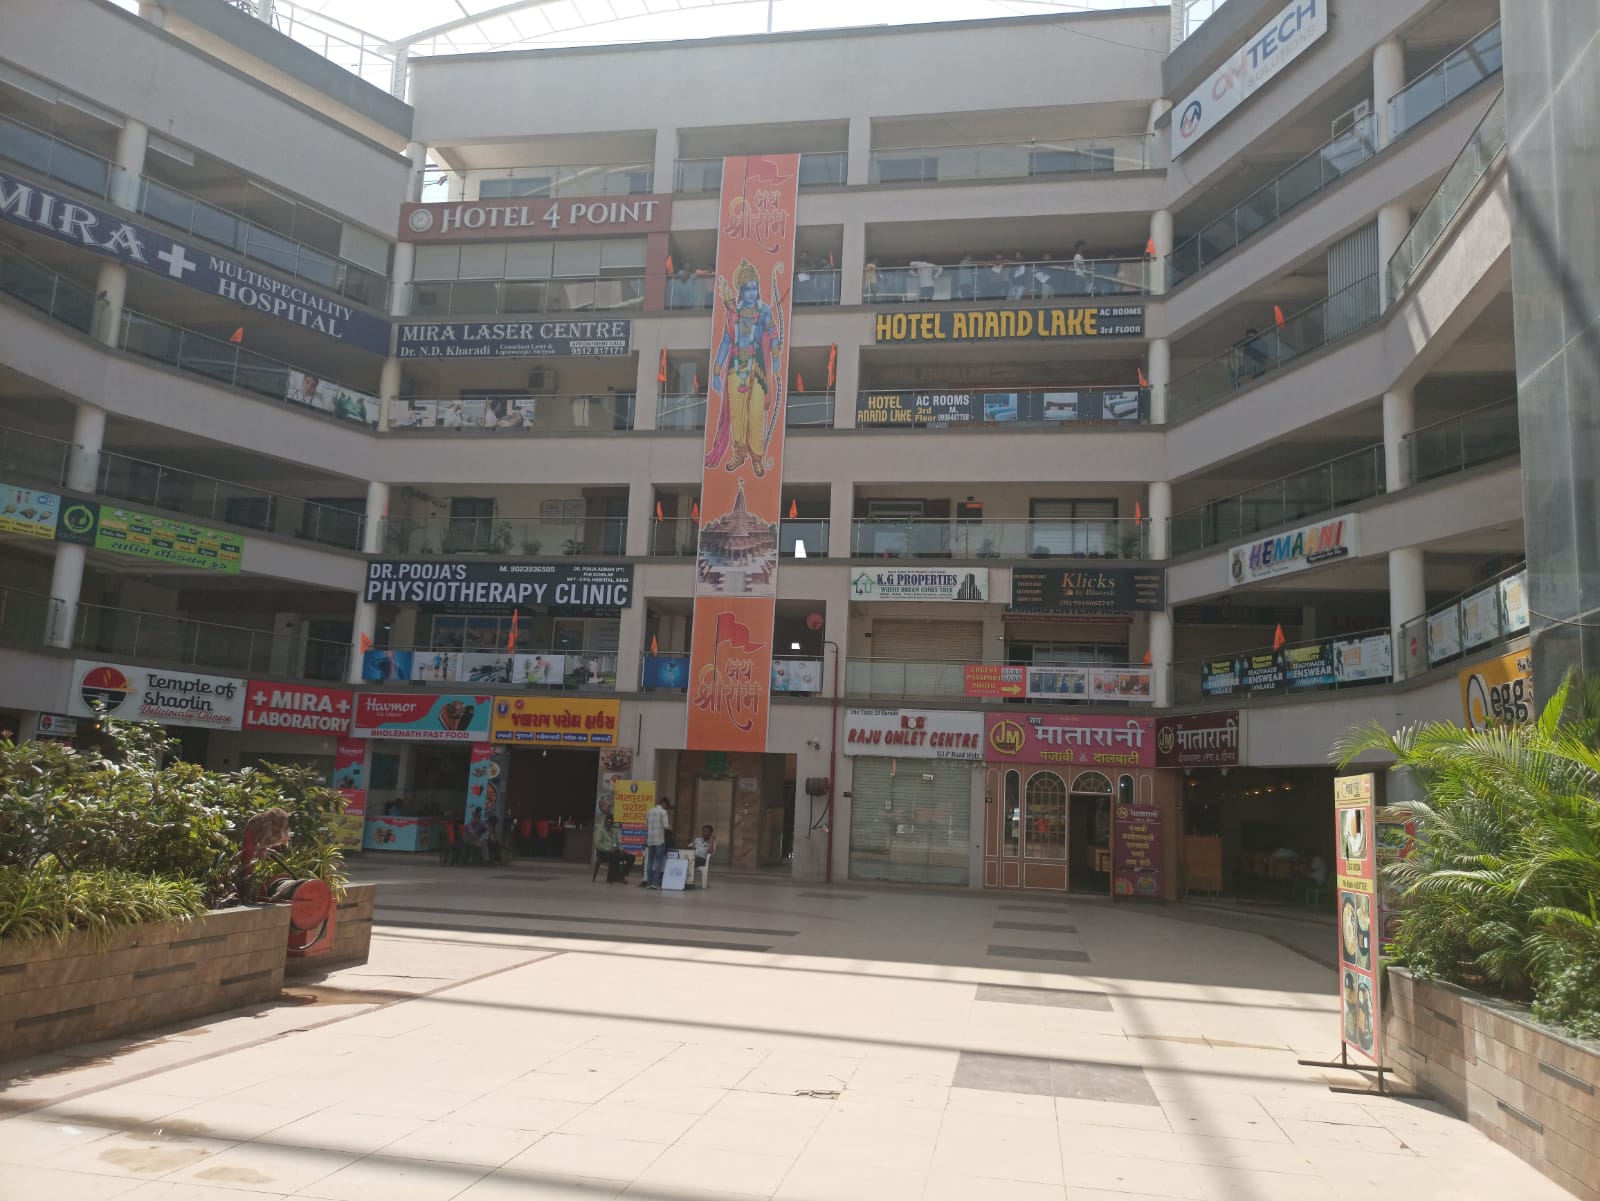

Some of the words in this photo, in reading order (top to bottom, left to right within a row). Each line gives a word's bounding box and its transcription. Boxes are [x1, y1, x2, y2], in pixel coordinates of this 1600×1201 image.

[0, 176, 148, 263] MIRA
[441, 204, 534, 232] HOTEL
[543, 203, 560, 229] 4
[569, 201, 658, 225] POINT
[209, 256, 354, 321] MULTISPECIALITY
[218, 277, 342, 338] HOSPITAL
[1113, 307, 1142, 315] ROOMS
[402, 326, 456, 342] MIRA
[463, 323, 533, 340] LASER
[540, 321, 625, 339] CENTRE
[876, 312, 945, 341] HOTEL
[953, 309, 1033, 339] ANAND
[1037, 308, 1098, 336] LAKE
[1100, 326, 1113, 334] 3rd
[400, 346, 416, 357] Dr.
[420, 346, 442, 357] N.D.
[446, 345, 490, 356] Kharadi
[868, 396, 902, 409] HOTEL
[916, 396, 929, 406] AC
[933, 395, 970, 406] ROOMS
[858, 410, 889, 422] ANAND
[890, 409, 912, 421] LAKE
[915, 414, 936, 422] Floor
[1249, 521, 1343, 569] HEMAANI
[897, 574, 958, 586] PROPERTIES
[1062, 572, 1116, 588] Klicks
[367, 581, 548, 604] PHYSIOTHERAPY
[555, 583, 629, 606] CLINIC
[147, 674, 212, 694] Temple
[216, 682, 236, 699] of
[144, 691, 213, 712] Shaolin
[271, 690, 333, 714] MIRA
[365, 697, 417, 713] Havmor
[248, 711, 349, 732] LABORATORY
[371, 730, 422, 738] BHOLENATH
[445, 731, 469, 739] FOOD
[847, 729, 882, 746] RAJU
[885, 730, 927, 746] OMLET
[930, 732, 979, 749] CENTRE
[1034, 720, 1145, 748] मातारानी
[1177, 719, 1238, 750] मातारानी
[1092, 751, 1140, 765] दालबाटी
